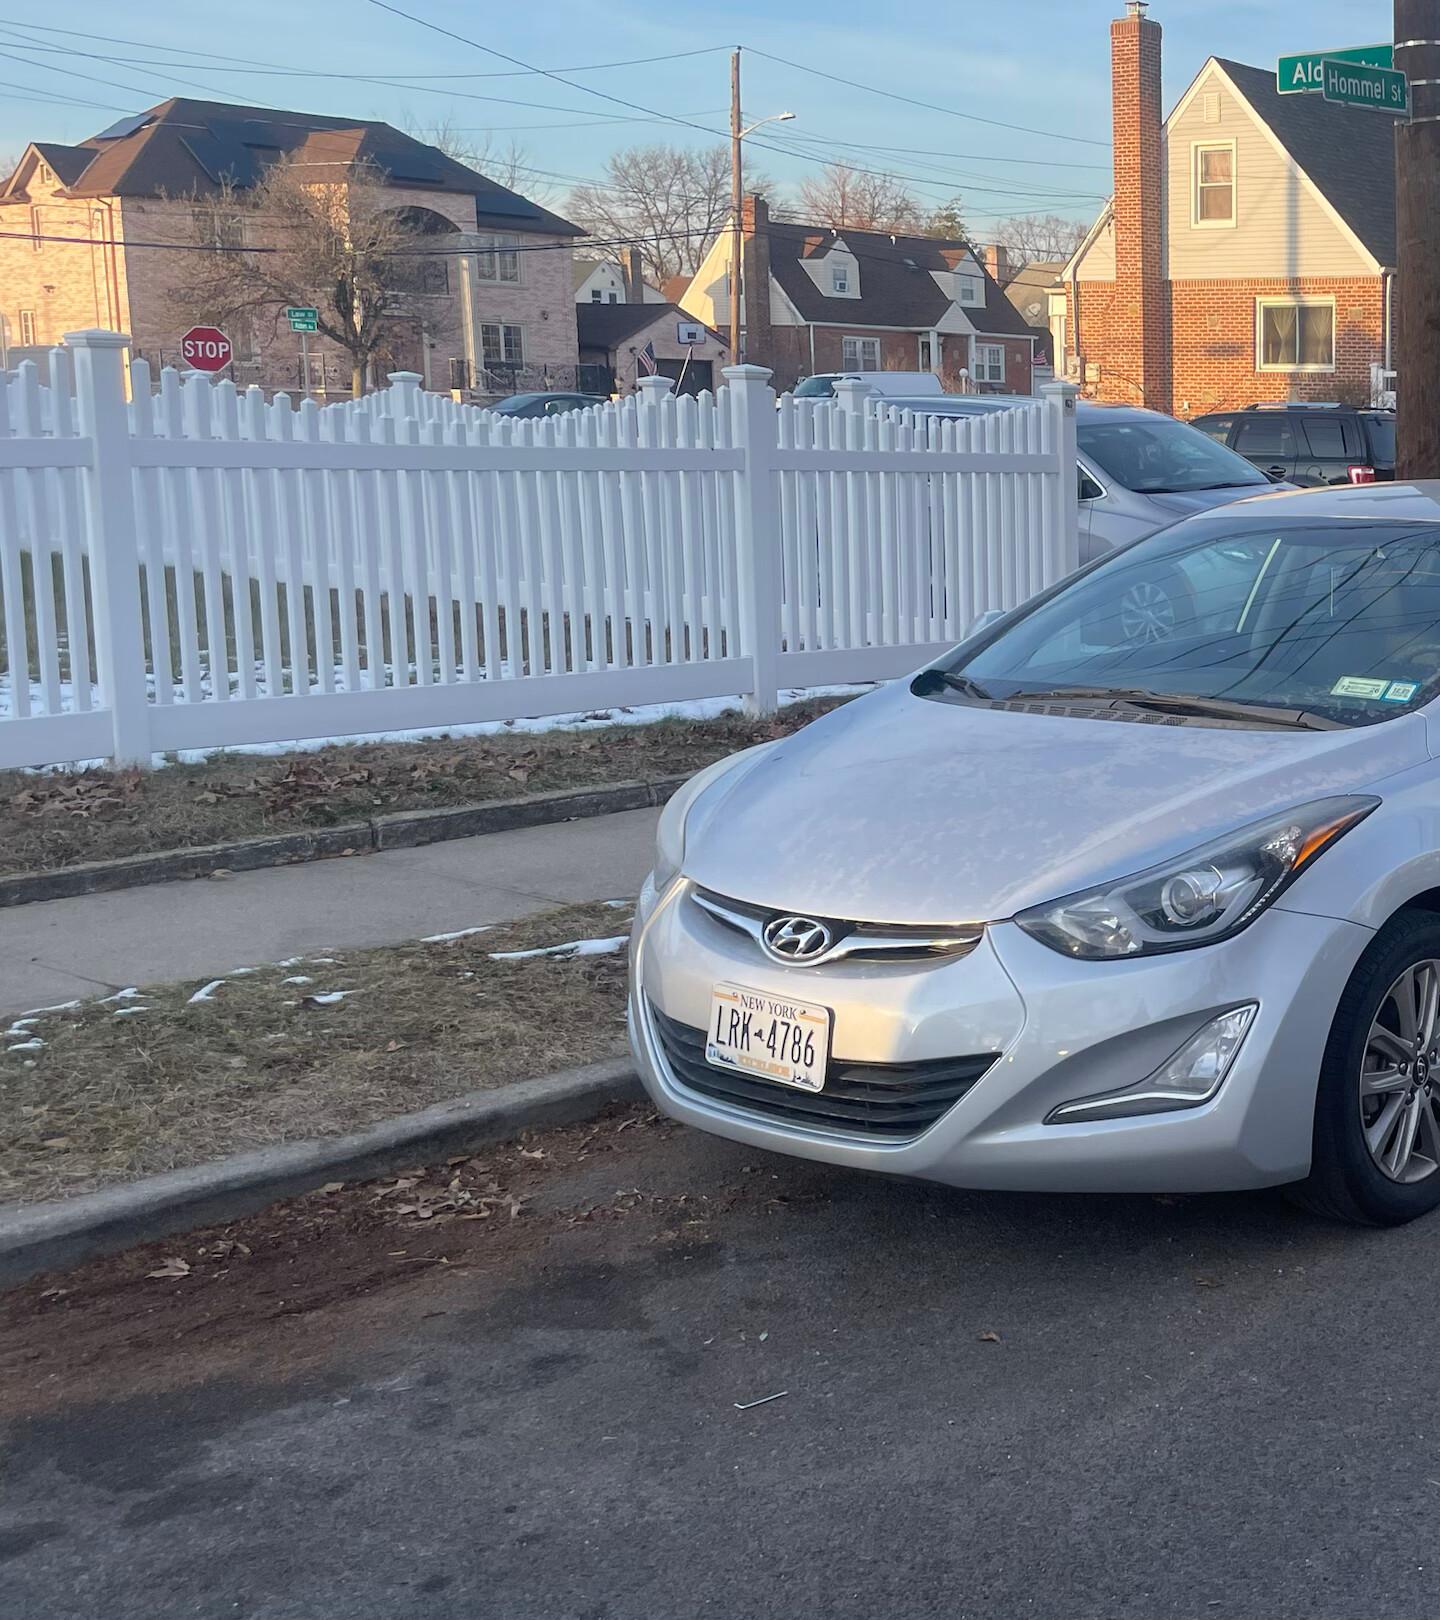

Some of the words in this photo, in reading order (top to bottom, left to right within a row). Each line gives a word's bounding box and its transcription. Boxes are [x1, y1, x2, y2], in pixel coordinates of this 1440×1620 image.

[1328, 69, 1385, 100] Hommel
[1391, 84, 1402, 102] St
[184, 340, 230, 359] STOP
[740, 994, 766, 1011] NEW
[768, 1001, 798, 1021] YORK
